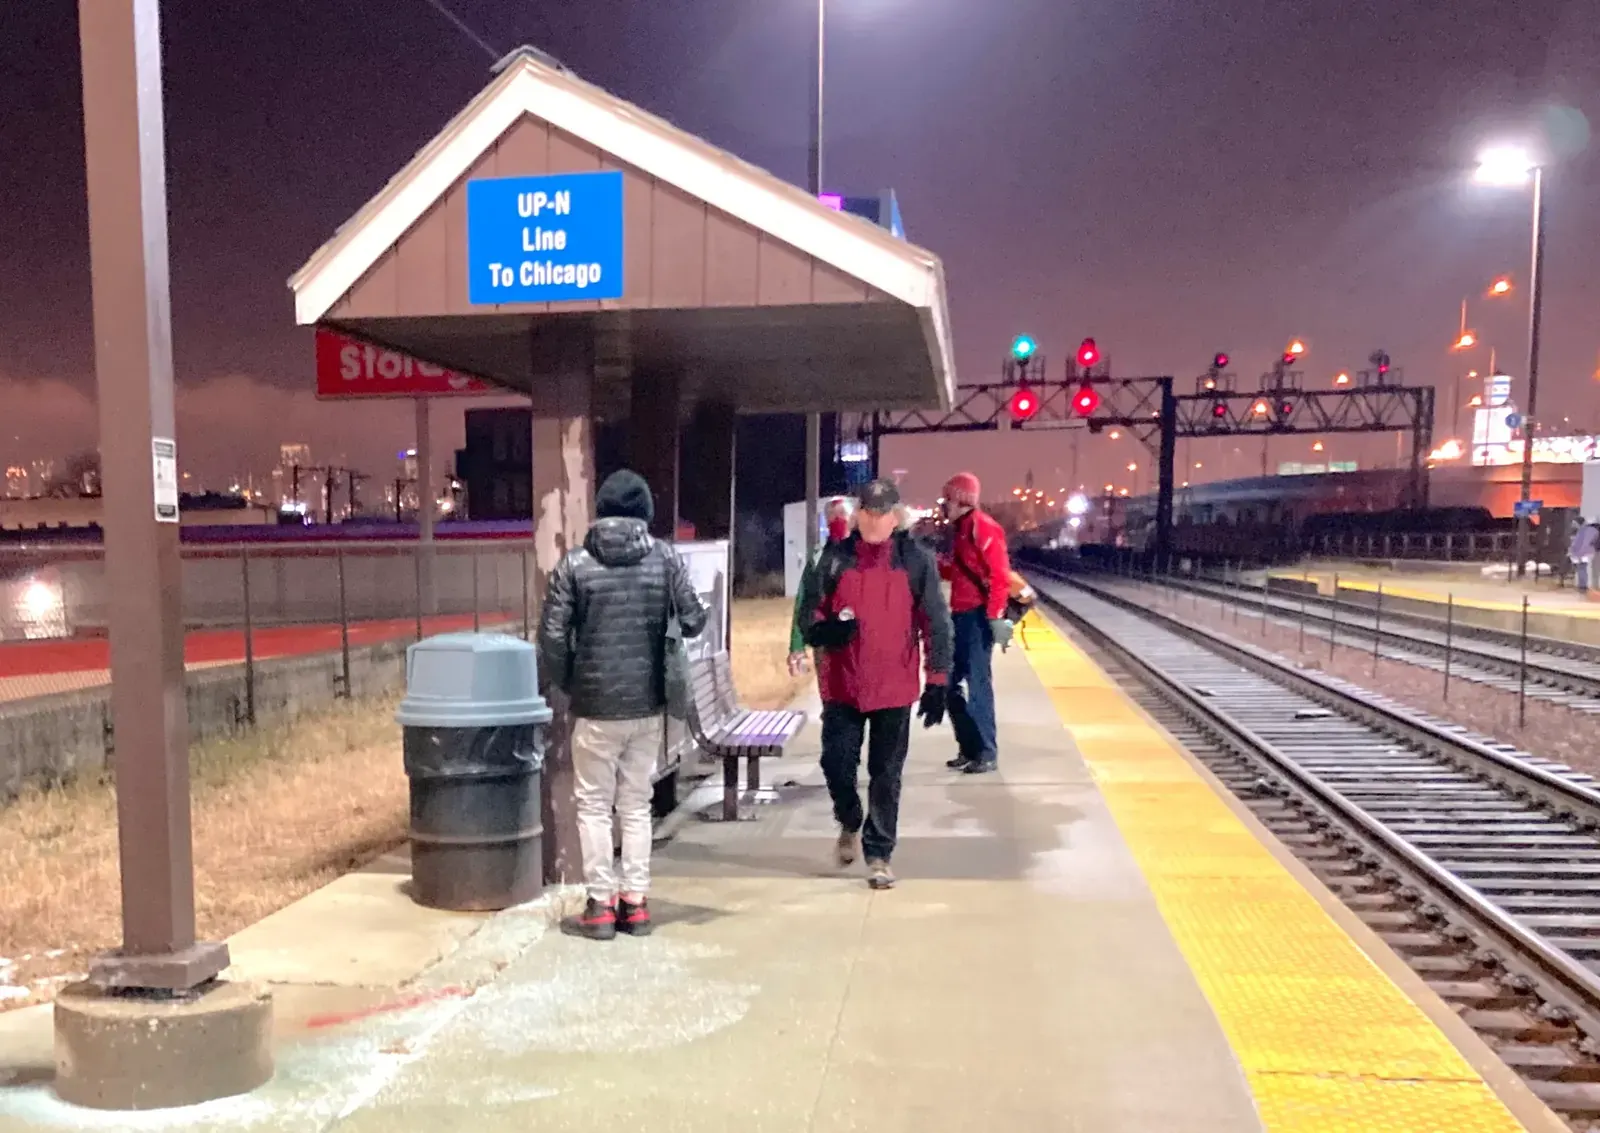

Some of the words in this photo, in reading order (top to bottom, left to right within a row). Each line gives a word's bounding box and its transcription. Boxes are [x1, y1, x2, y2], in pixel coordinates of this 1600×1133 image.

[517, 190, 571, 218] UP-N
[522, 226, 567, 252] Line
[488, 262, 514, 288] To
[519, 260, 602, 289] Chicago
[339, 344, 469, 388] Stor
